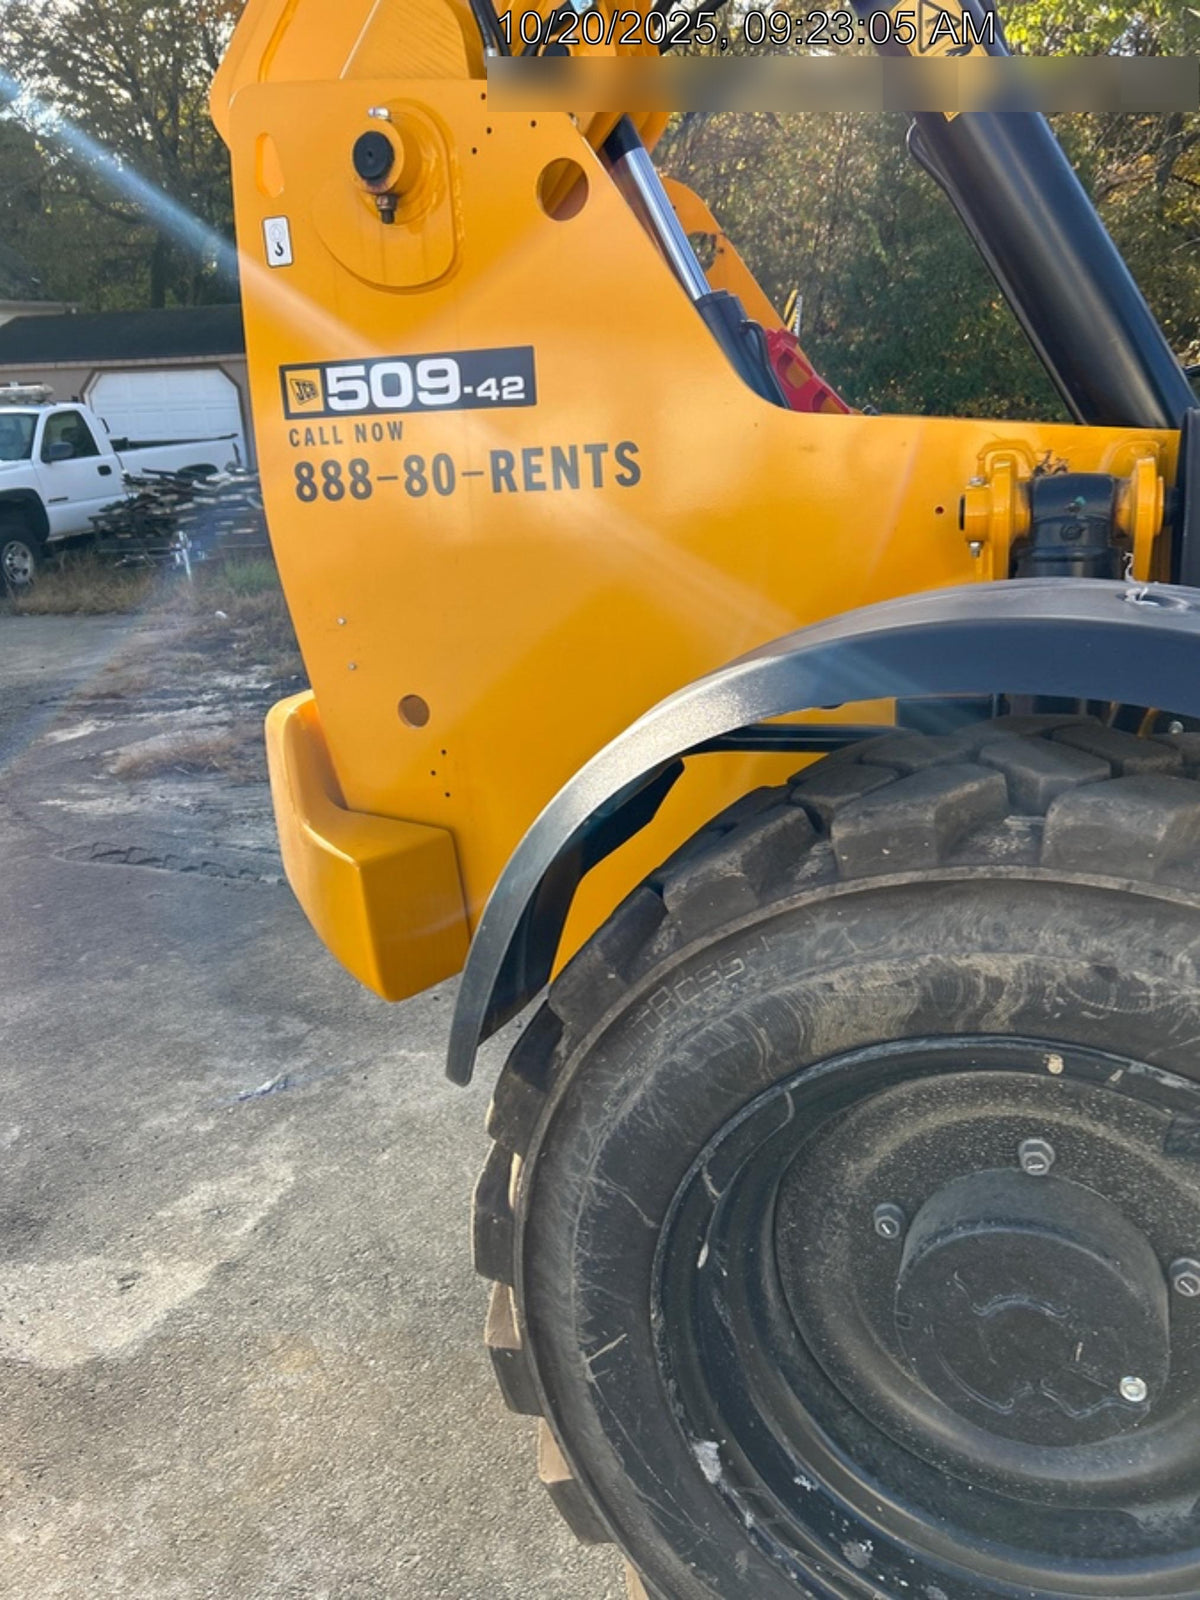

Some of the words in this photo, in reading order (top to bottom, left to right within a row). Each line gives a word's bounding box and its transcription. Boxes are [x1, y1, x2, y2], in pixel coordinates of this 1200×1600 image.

[292, 379, 318, 403] JCB
[325, 357, 525, 411] 509-42
[288, 423, 343, 448] CALL
[354, 420, 404, 444] NOW
[294, 440, 642, 502] 888-80-RENTS
